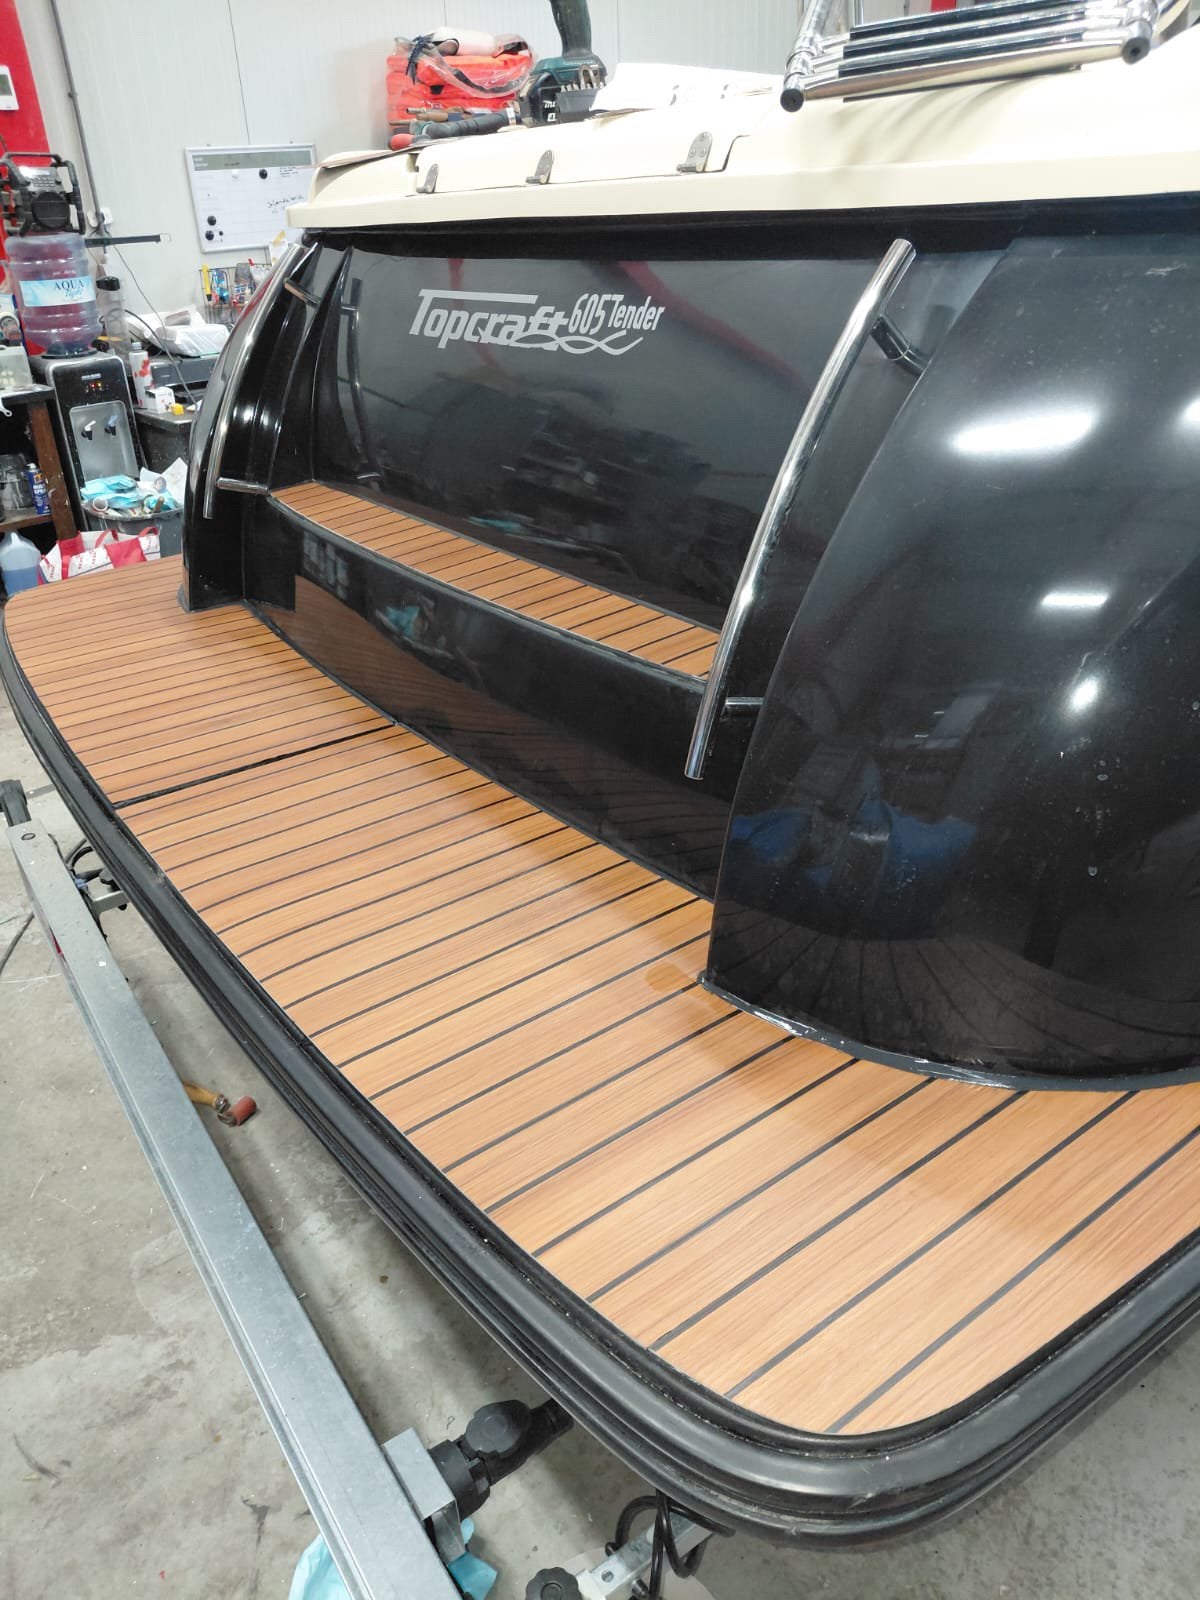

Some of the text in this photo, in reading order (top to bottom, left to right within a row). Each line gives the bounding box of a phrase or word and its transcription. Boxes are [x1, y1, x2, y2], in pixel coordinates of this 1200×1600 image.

[54, 279, 84, 290] AQUA
[408, 289, 666, 351] Topcraft 605 Tender
